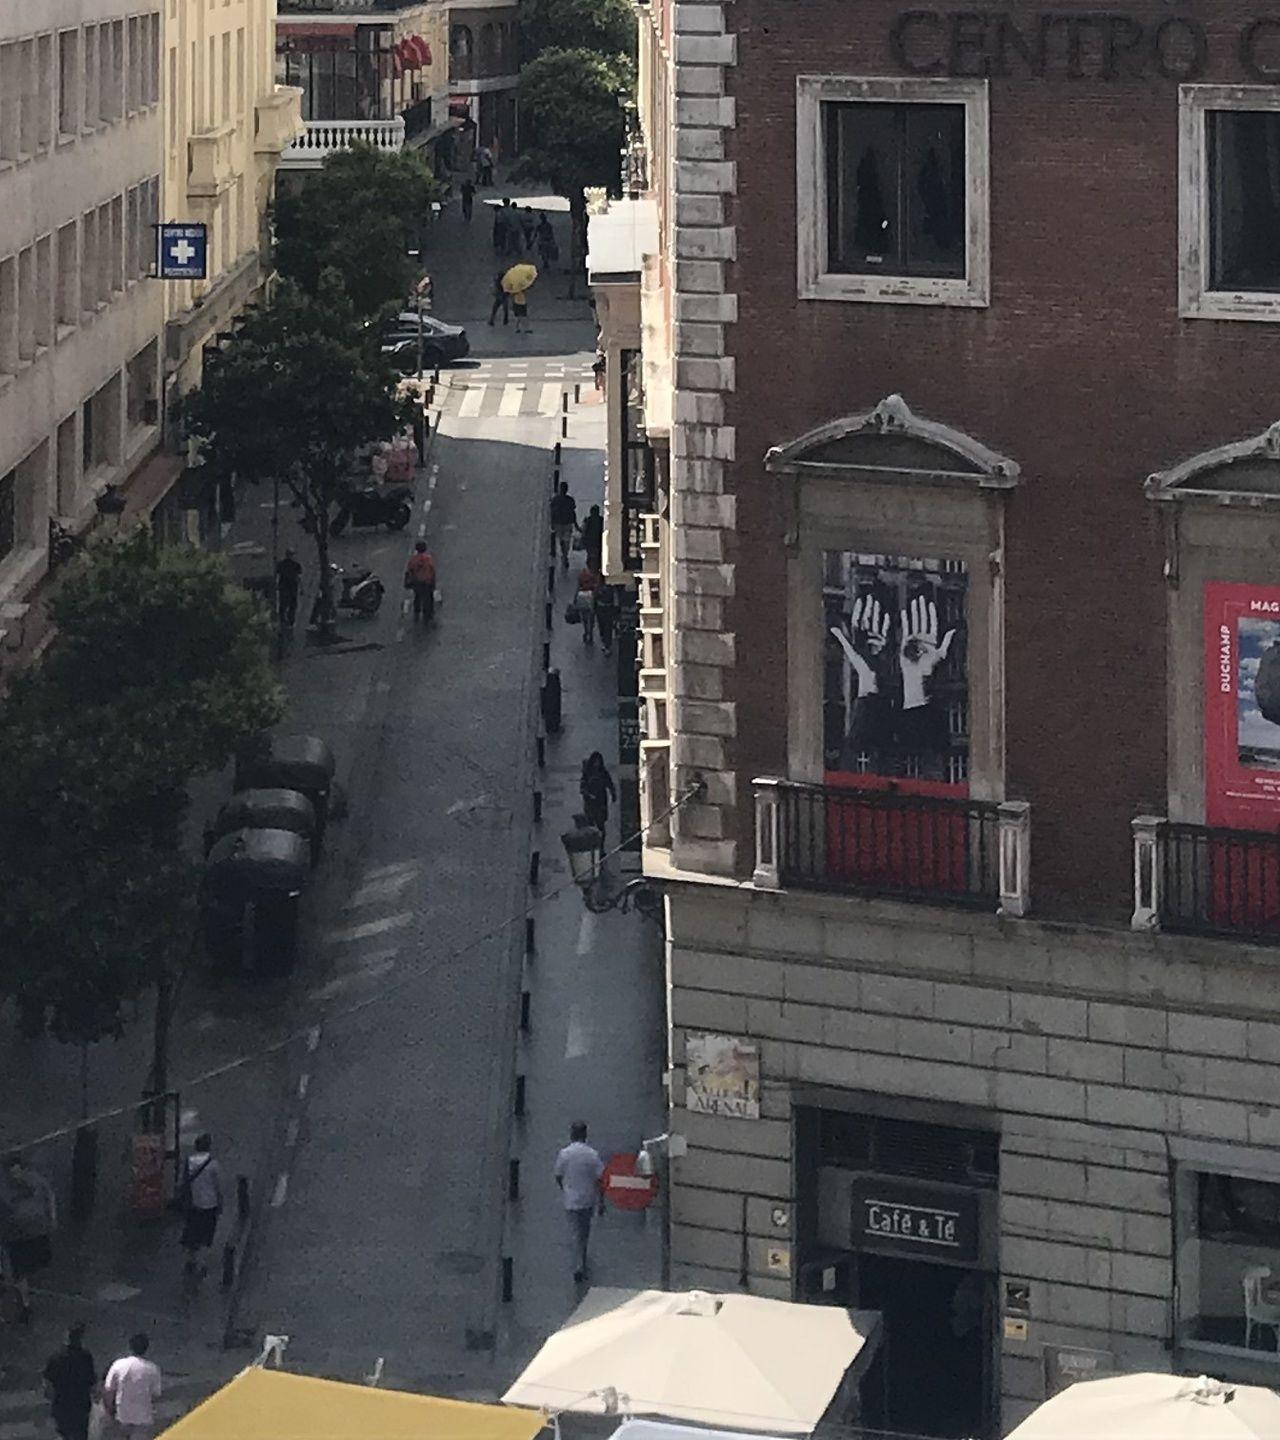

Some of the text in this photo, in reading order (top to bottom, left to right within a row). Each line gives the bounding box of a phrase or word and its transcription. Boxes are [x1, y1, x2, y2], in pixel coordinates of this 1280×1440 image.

[888, 10, 1207, 81] CENTRO
[1220, 625, 1231, 692] DUCHAMP
[869, 1206, 955, 1241] Café & Té
